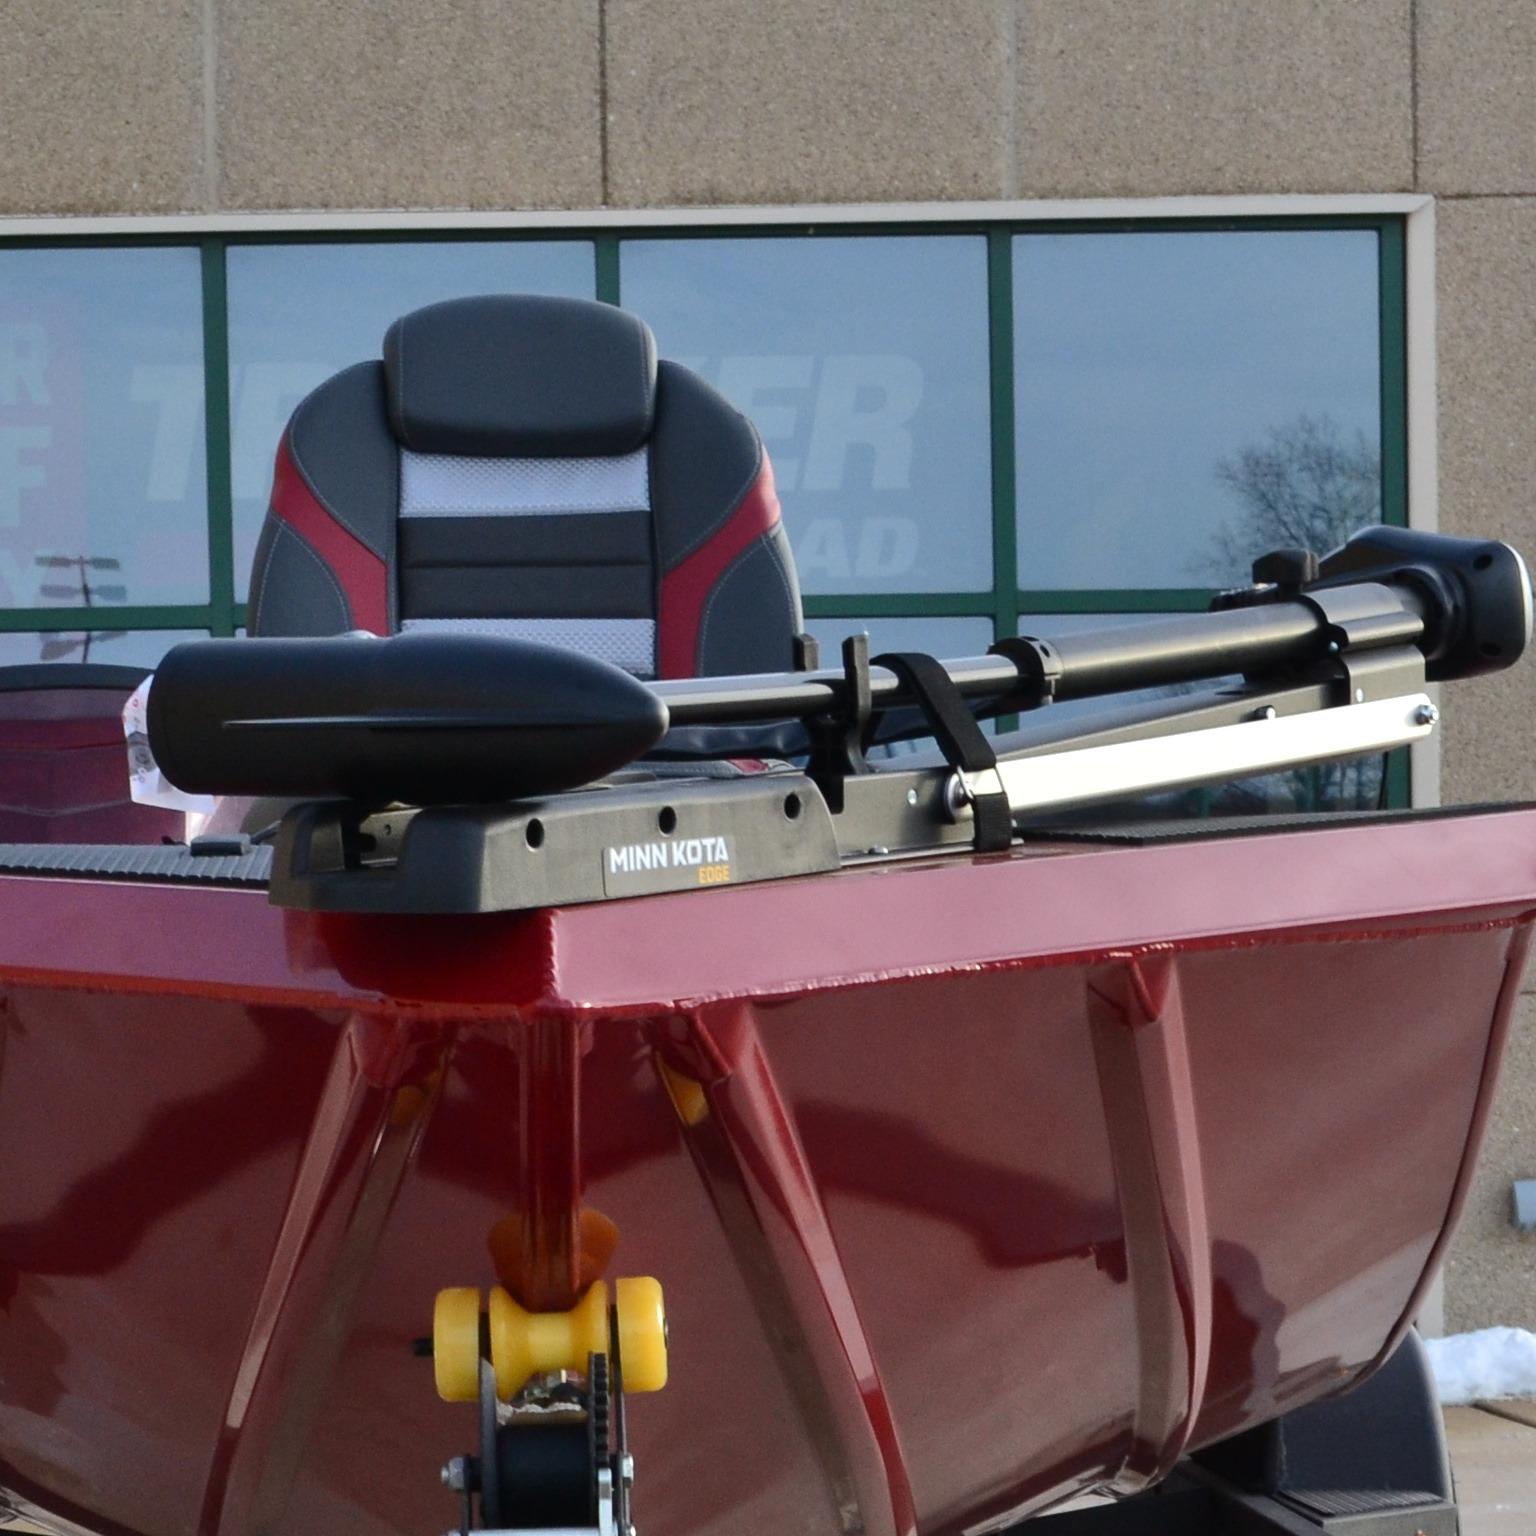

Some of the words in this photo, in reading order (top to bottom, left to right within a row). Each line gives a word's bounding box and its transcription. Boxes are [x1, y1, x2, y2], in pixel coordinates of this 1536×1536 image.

[610, 843, 668, 873] MINN
[672, 837, 729, 866] KOTA
[699, 866, 729, 884] EDGE
